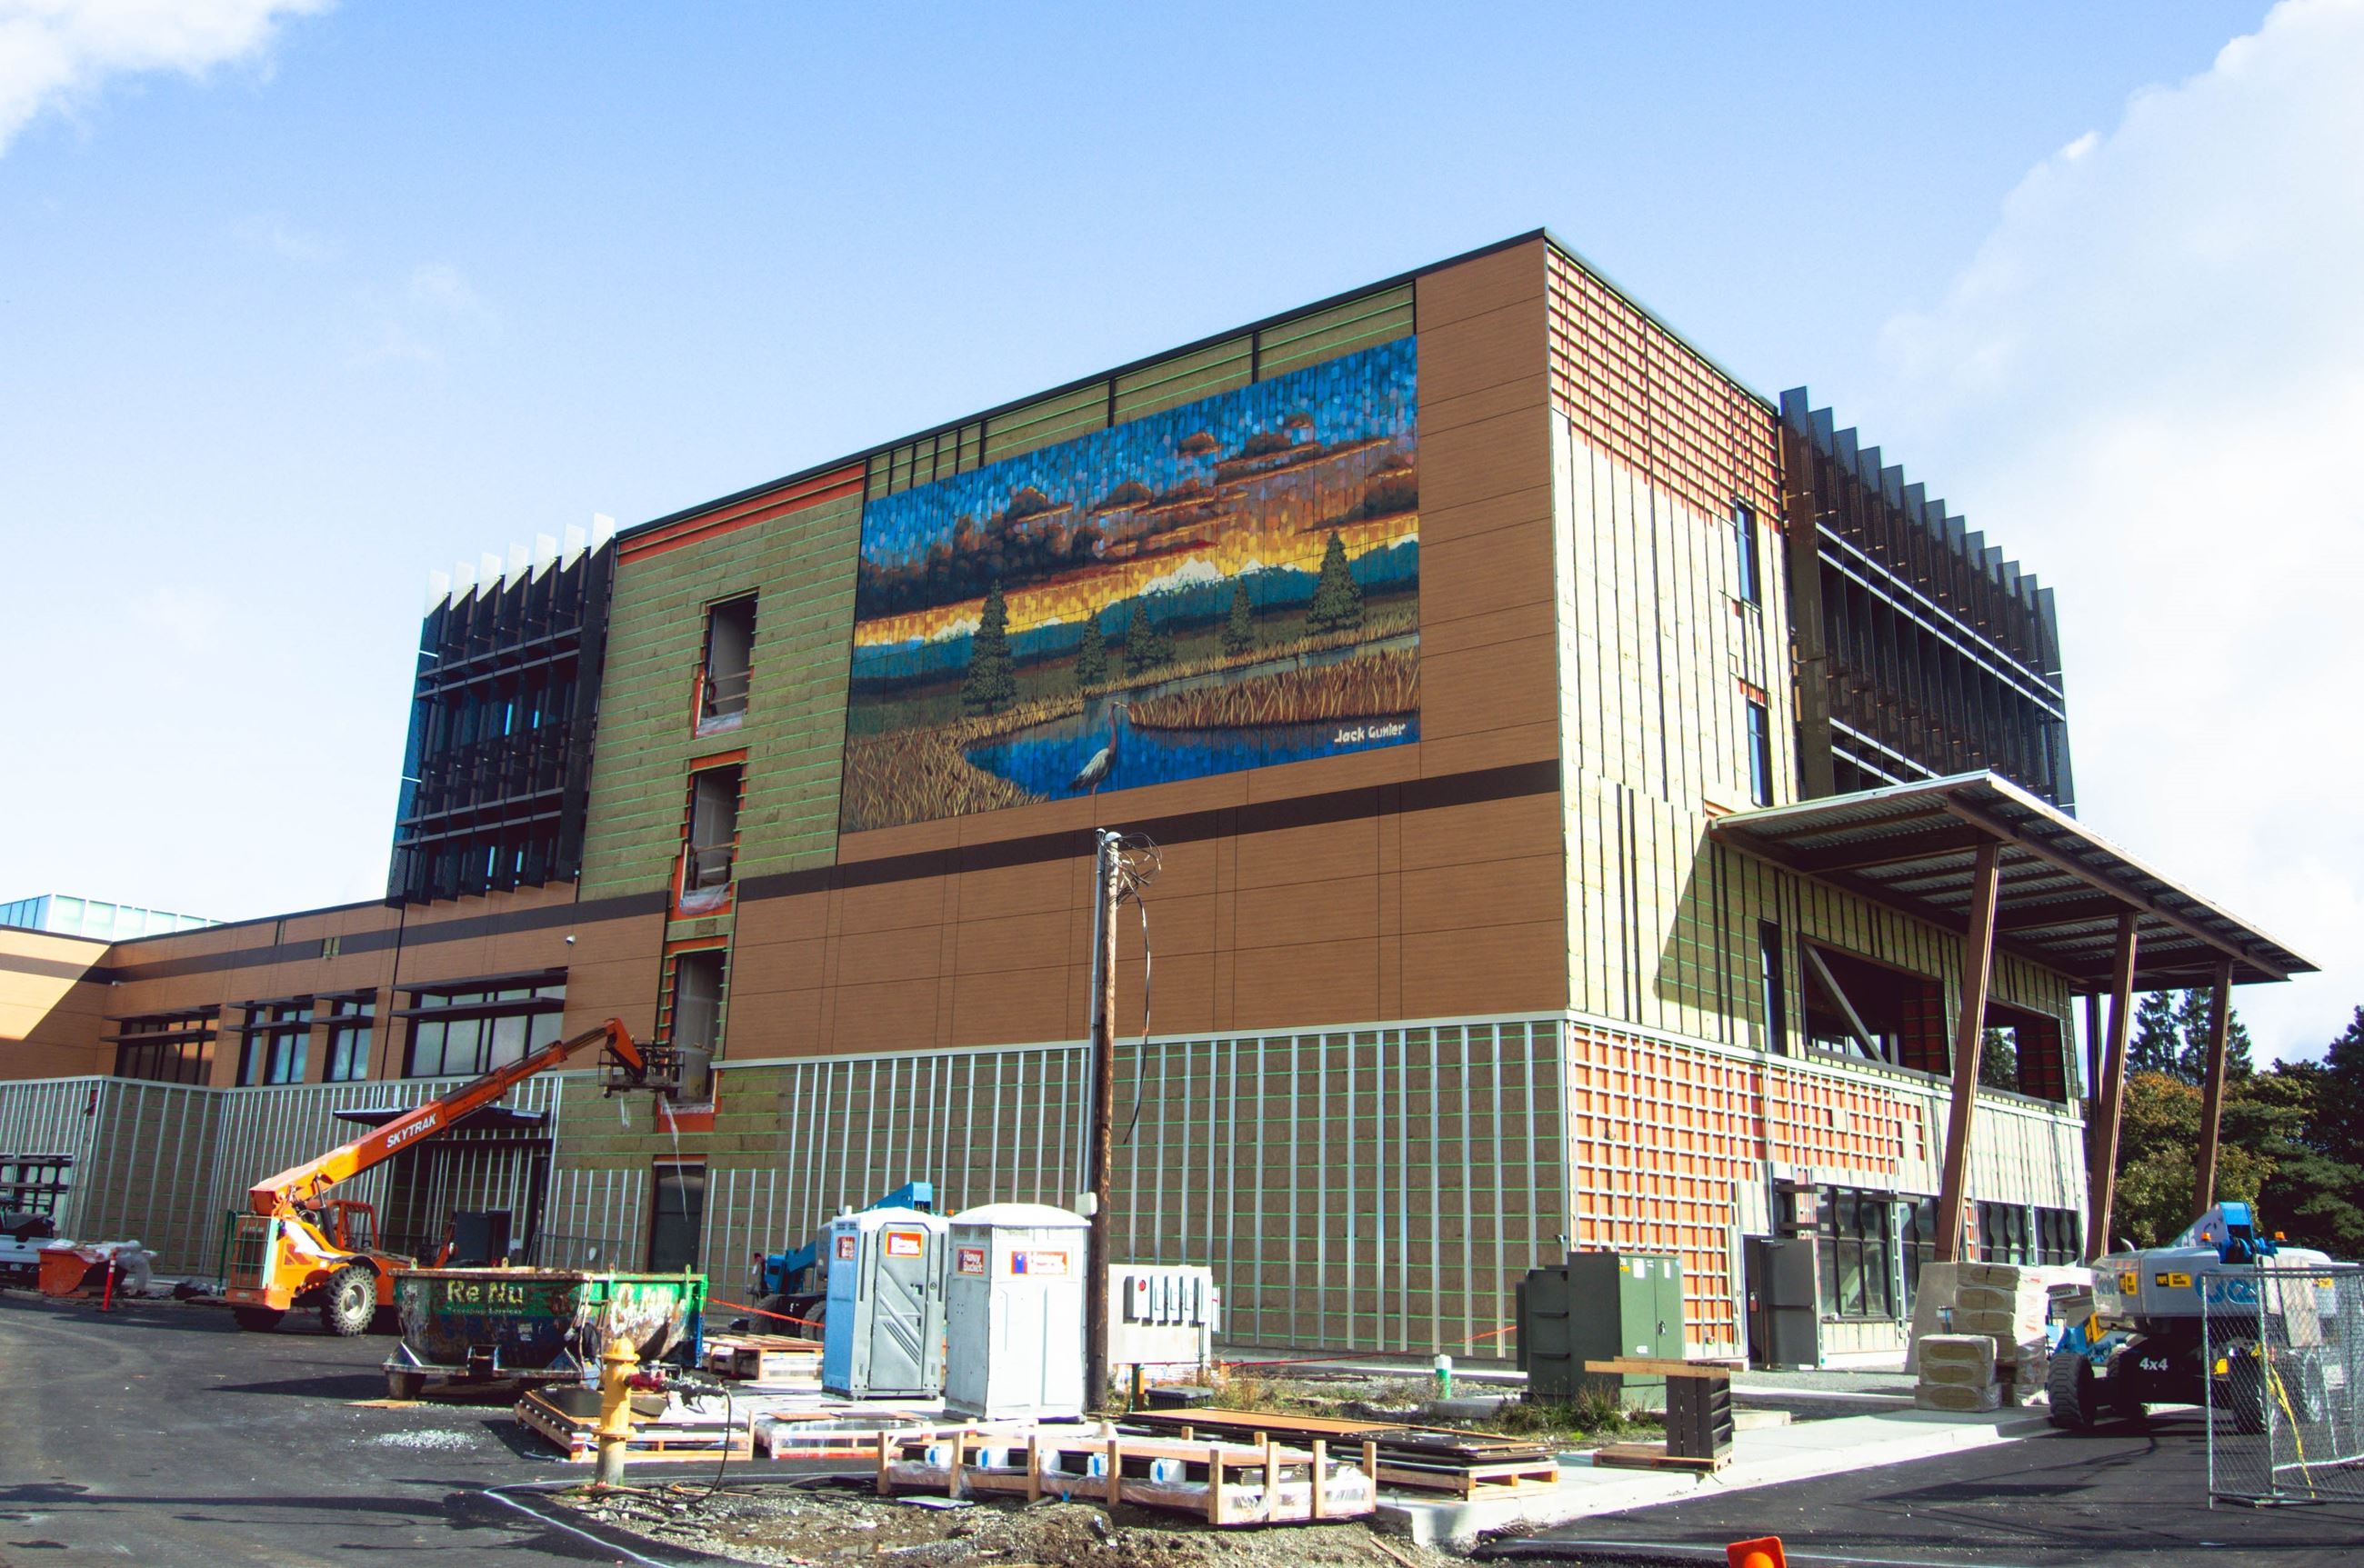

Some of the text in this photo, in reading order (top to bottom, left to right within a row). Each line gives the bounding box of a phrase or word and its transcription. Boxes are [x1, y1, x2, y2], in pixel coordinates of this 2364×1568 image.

[1334, 726, 1365, 743] Jack
[386, 1113, 436, 1148] SKYTRAK
[963, 1251, 982, 1264] Honey
[447, 1280, 480, 1303] Re
[2139, 1357, 2169, 1371] 4x4
